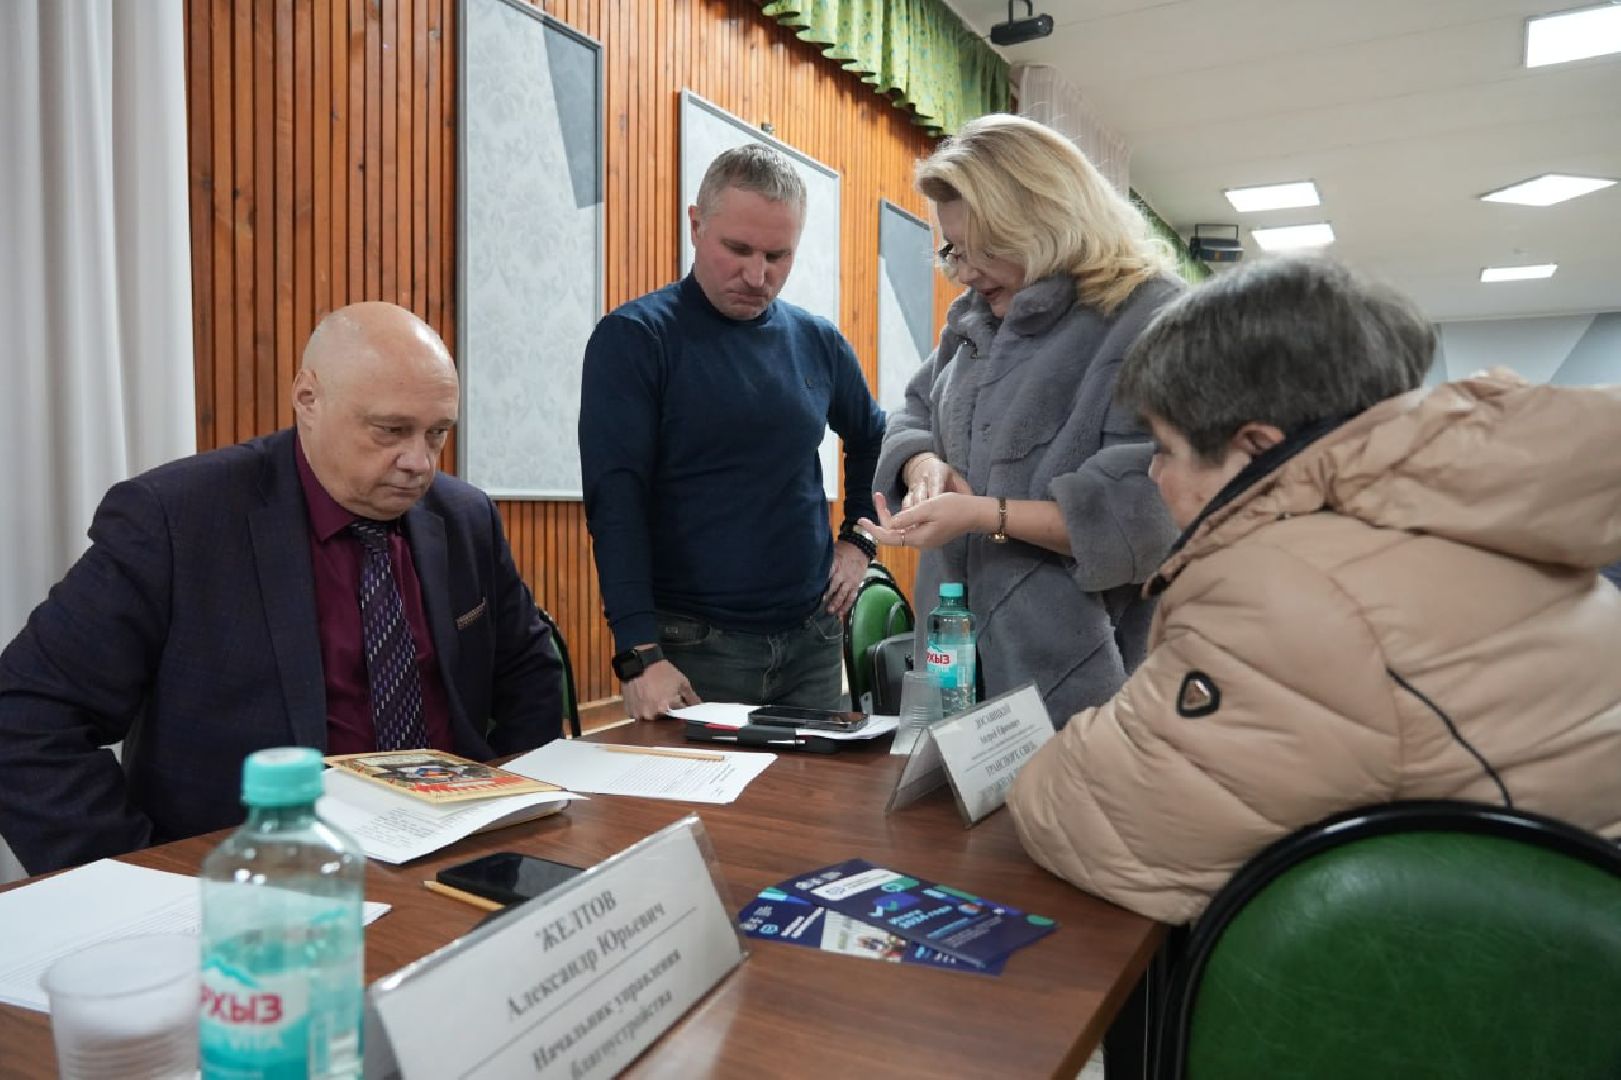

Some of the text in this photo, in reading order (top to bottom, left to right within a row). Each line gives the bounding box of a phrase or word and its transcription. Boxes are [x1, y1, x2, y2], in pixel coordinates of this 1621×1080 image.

[506, 948, 598, 1022] Александр
[597, 903, 666, 955] Юрьевич
[535, 890, 617, 952] ЖЕЛТОВ
[532, 949, 682, 1072] Начальник управления
